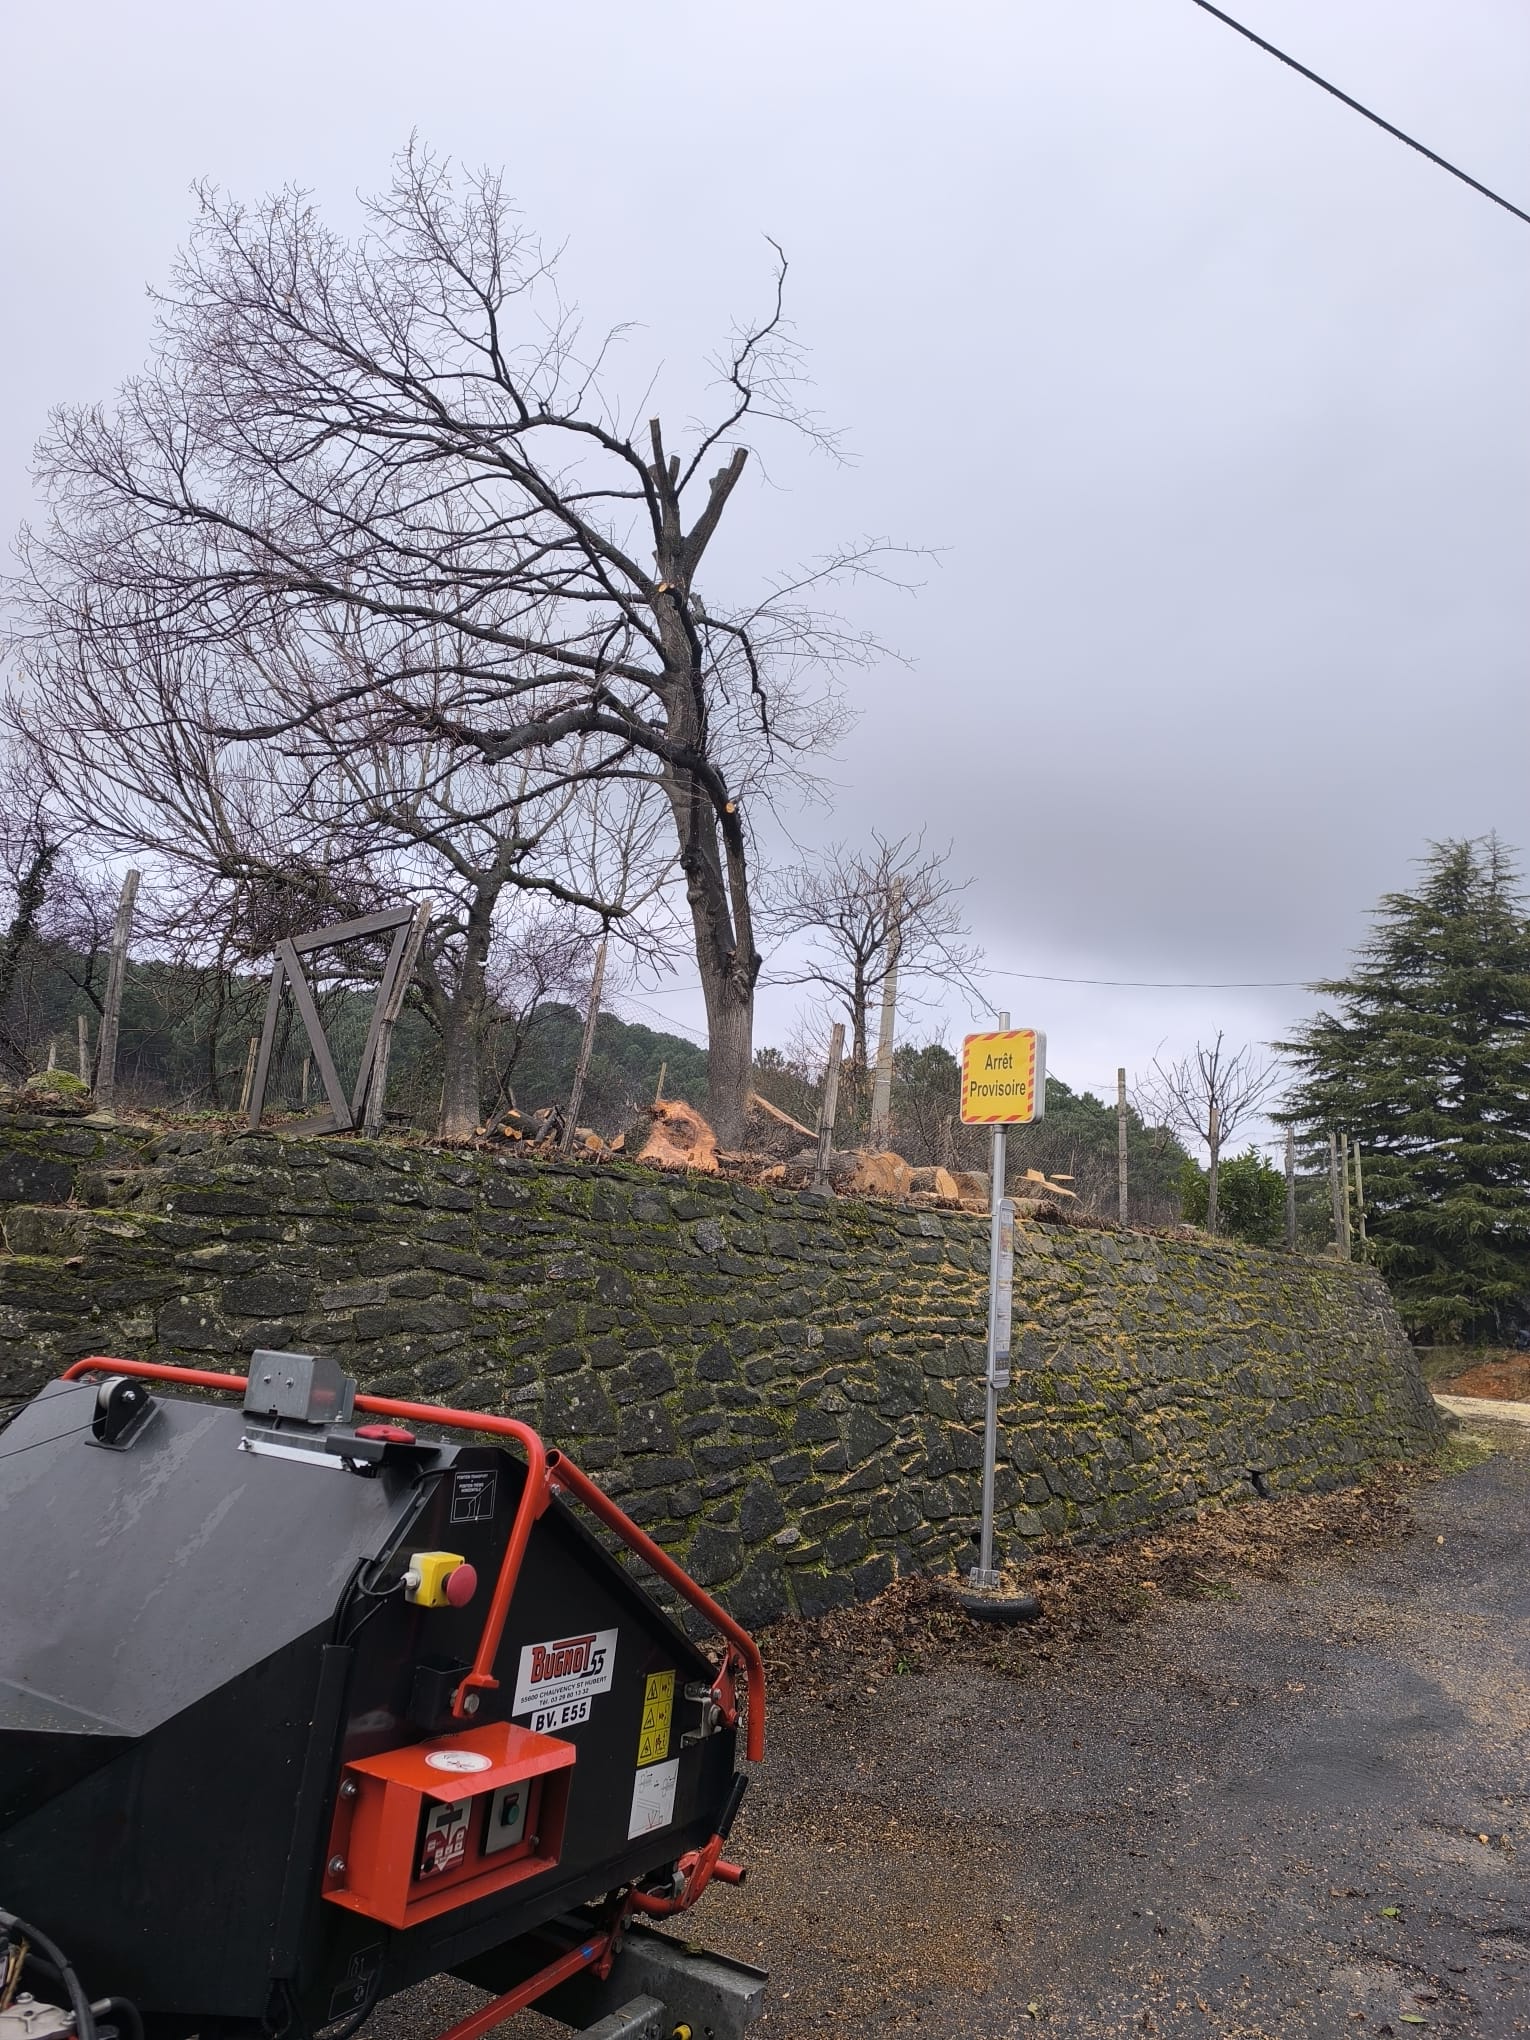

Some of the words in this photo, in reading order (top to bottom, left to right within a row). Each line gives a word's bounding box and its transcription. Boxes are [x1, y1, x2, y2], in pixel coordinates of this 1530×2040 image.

[985, 1053, 1013, 1070] Arrêt
[970, 1080, 1026, 1097] Provisoire
[580, 1648, 607, 1679] 55
[576, 1681, 584, 1689] ST
[535, 1710, 557, 1732] BV.
[561, 1702, 587, 1724] E55
